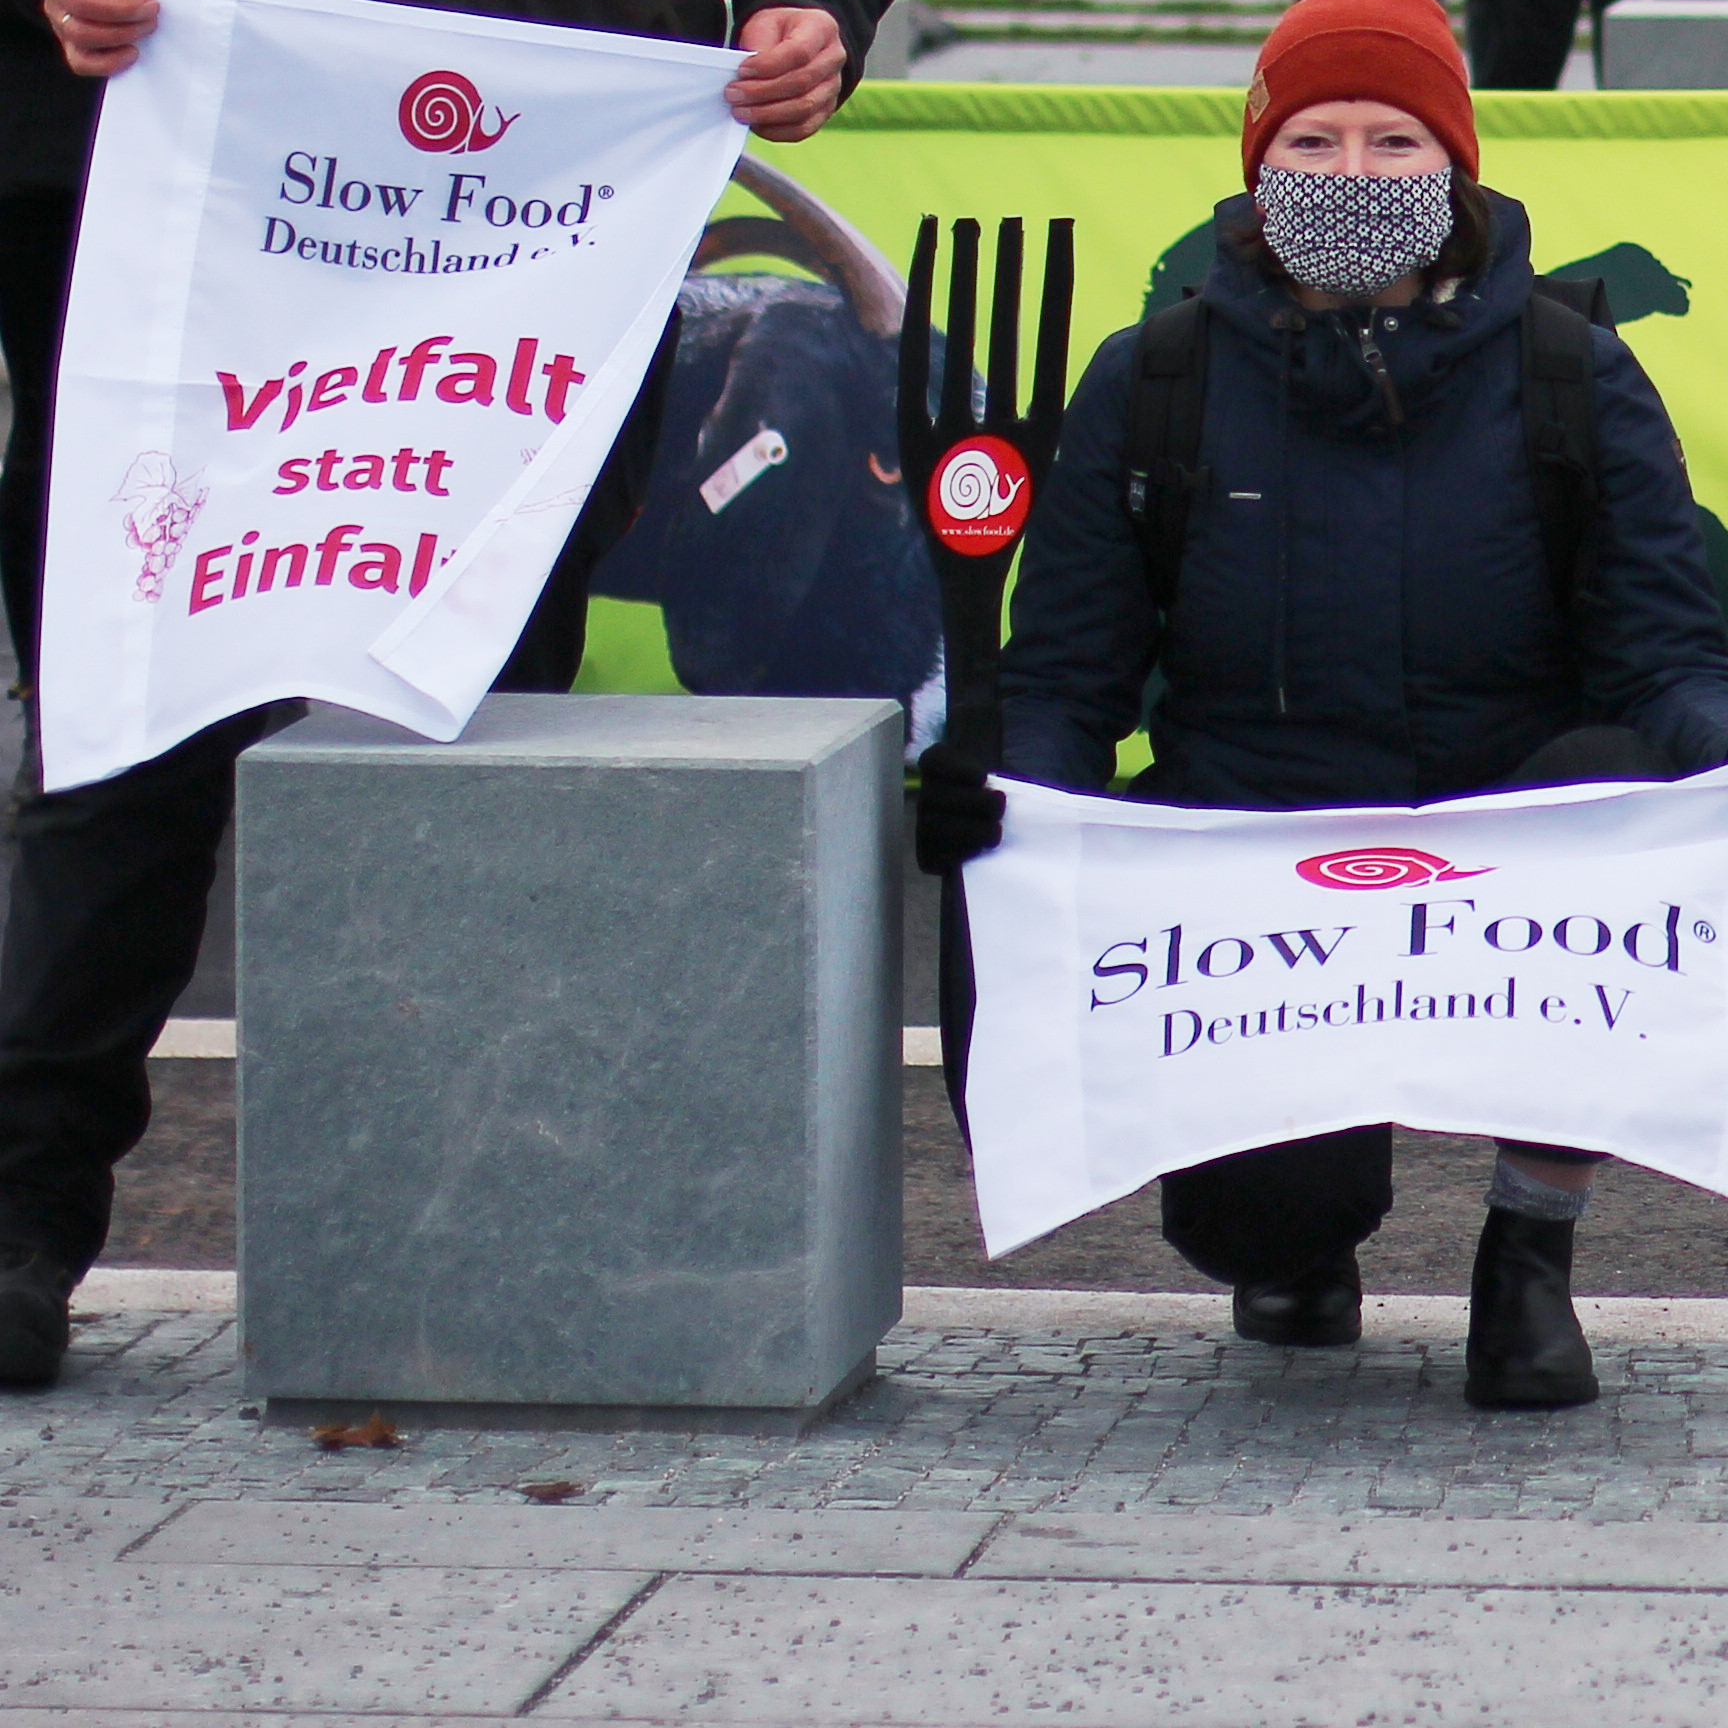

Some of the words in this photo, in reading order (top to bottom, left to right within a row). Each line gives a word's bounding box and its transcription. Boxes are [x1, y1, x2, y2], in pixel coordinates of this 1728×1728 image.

[279, 151, 425, 218] Slow
[259, 215, 520, 274] Deutschland
[214, 335, 588, 434] Vielfalt
[271, 447, 455, 497] statt
[188, 524, 458, 617] Einfal
[1089, 919, 1355, 1012] Slow
[1157, 975, 1518, 1059] Deutschland
